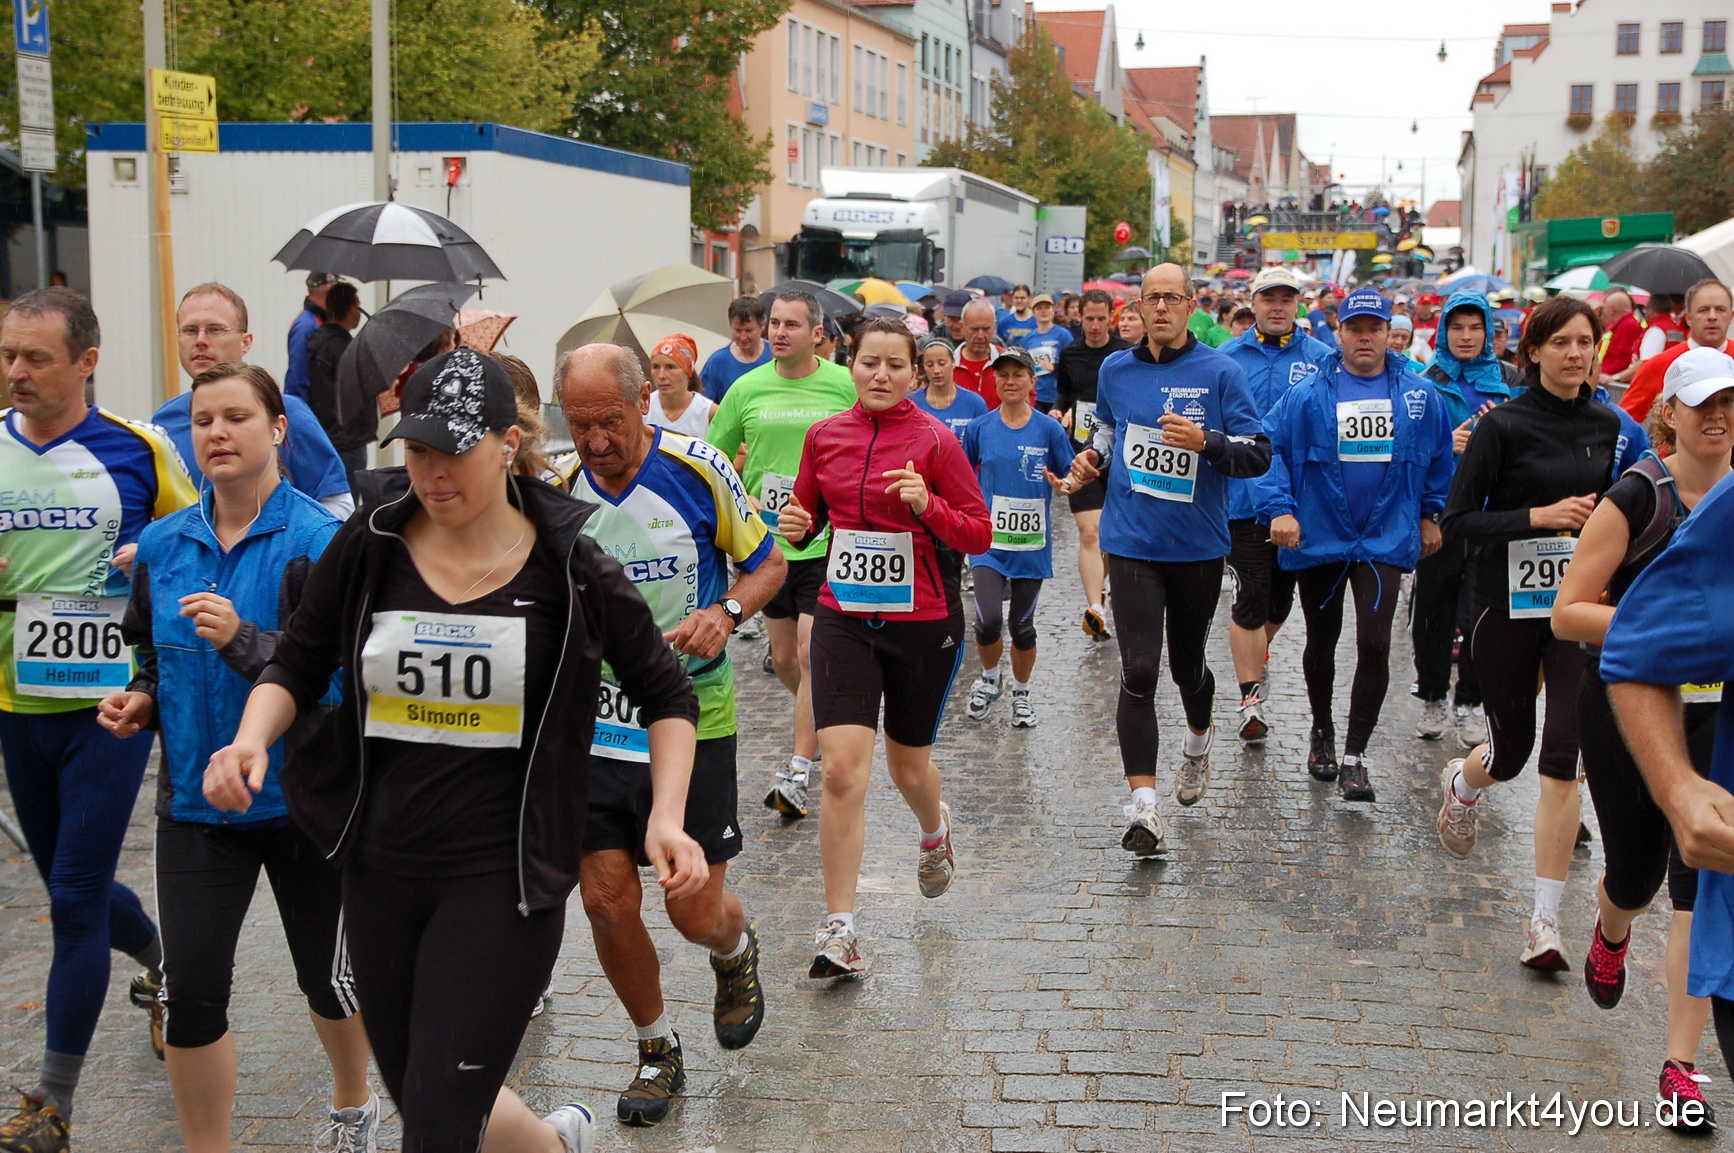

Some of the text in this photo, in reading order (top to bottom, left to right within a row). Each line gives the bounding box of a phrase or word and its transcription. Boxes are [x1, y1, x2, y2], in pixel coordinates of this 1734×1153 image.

[163, 74, 199, 92] Kinder-
[157, 91, 205, 115] betreuung
[833, 209, 895, 223] BOCK
[1298, 236, 1337, 246] START
[1357, 444, 1390, 453] Goswin
[1130, 444, 1191, 476] 2839
[687, 441, 753, 523] BOCK
[1142, 475, 1172, 490] Arnold
[0, 488, 56, 506] EAM
[766, 488, 791, 512] 32
[0, 507, 99, 532] BOCK
[996, 511, 1041, 532] 5083
[854, 536, 887, 546] BOCK
[1007, 535, 1027, 544] Doris
[1536, 542, 1571, 552] BOCK
[623, 556, 680, 583] CK
[836, 551, 905, 583] 3389
[52, 600, 99, 611] BOCK
[1532, 594, 1556, 606] Mel
[414, 621, 477, 639] BOCK
[27, 620, 121, 659] 2806
[45, 667, 101, 682] Helmut
[397, 650, 491, 700] 510
[406, 703, 481, 727] Simone
